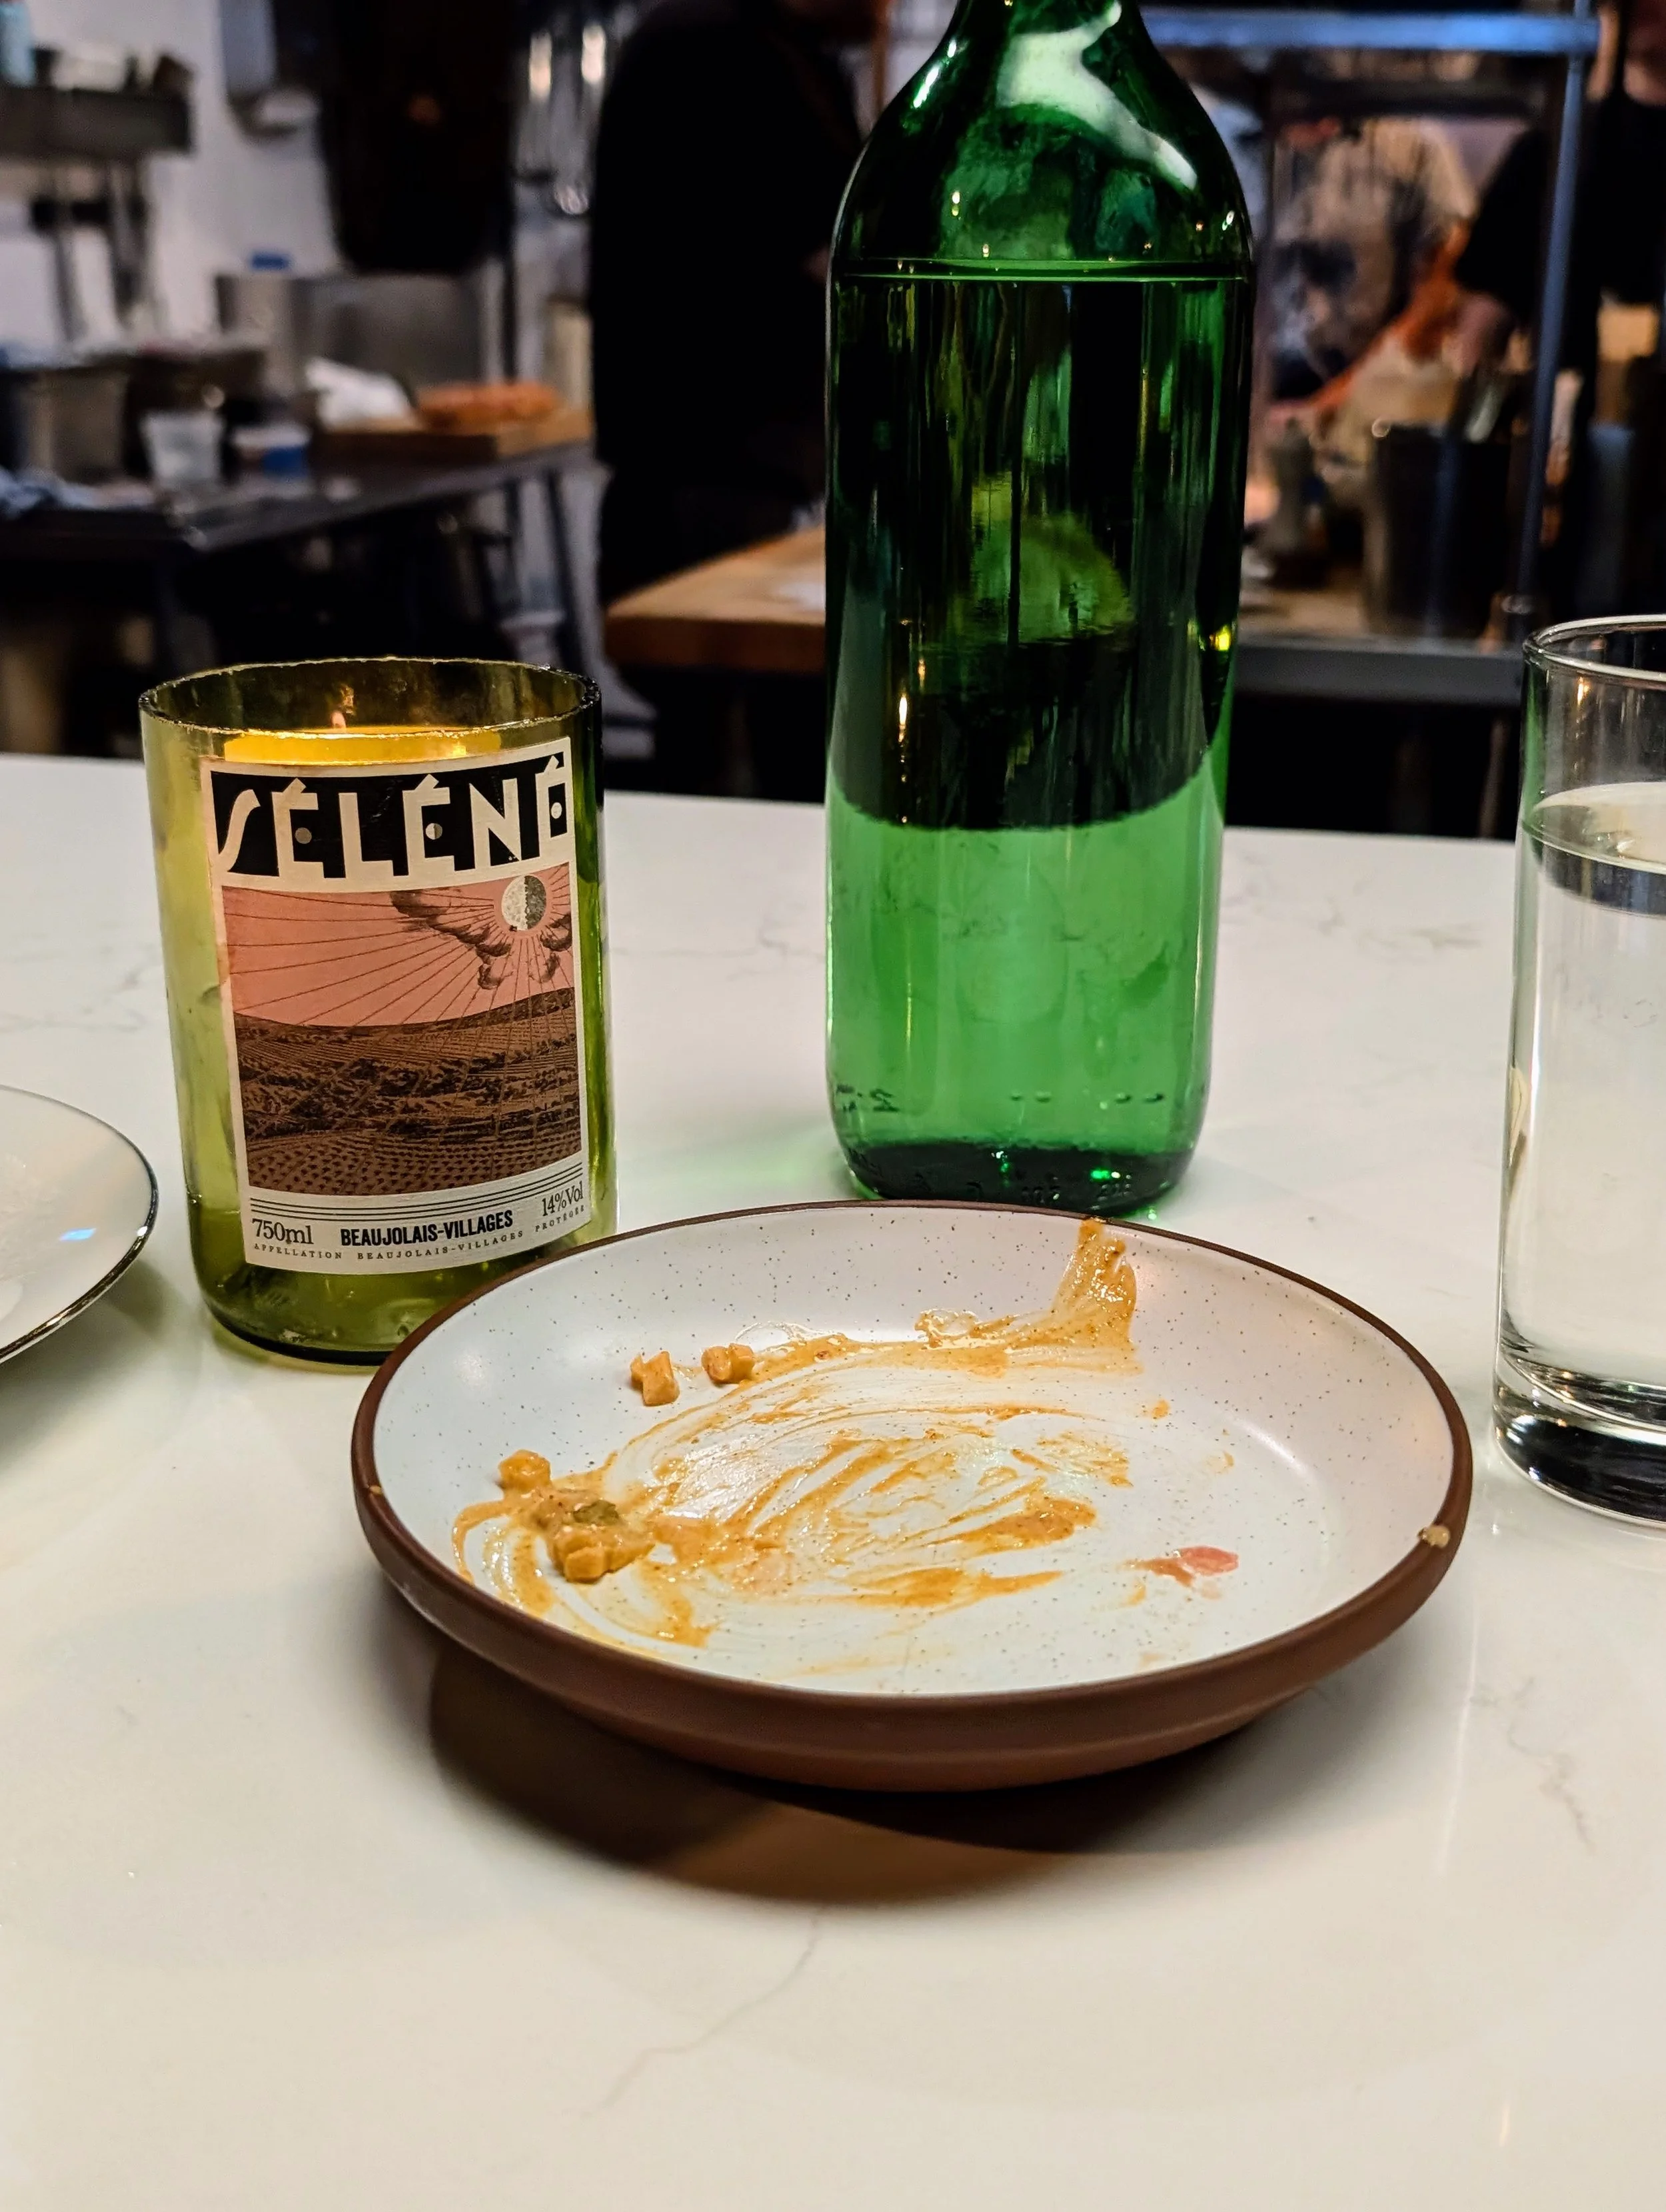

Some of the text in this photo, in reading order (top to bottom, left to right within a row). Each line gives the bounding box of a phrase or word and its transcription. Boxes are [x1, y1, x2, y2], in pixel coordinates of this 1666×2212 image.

[252, 1218, 314, 1245] 750ml
[340, 1209, 513, 1246] BEAUJOLAIS-VILLAGES
[254, 1243, 343, 1259] APPELLATION
[357, 1231, 524, 1260] BEAUJOLAIS-VILLAGES
